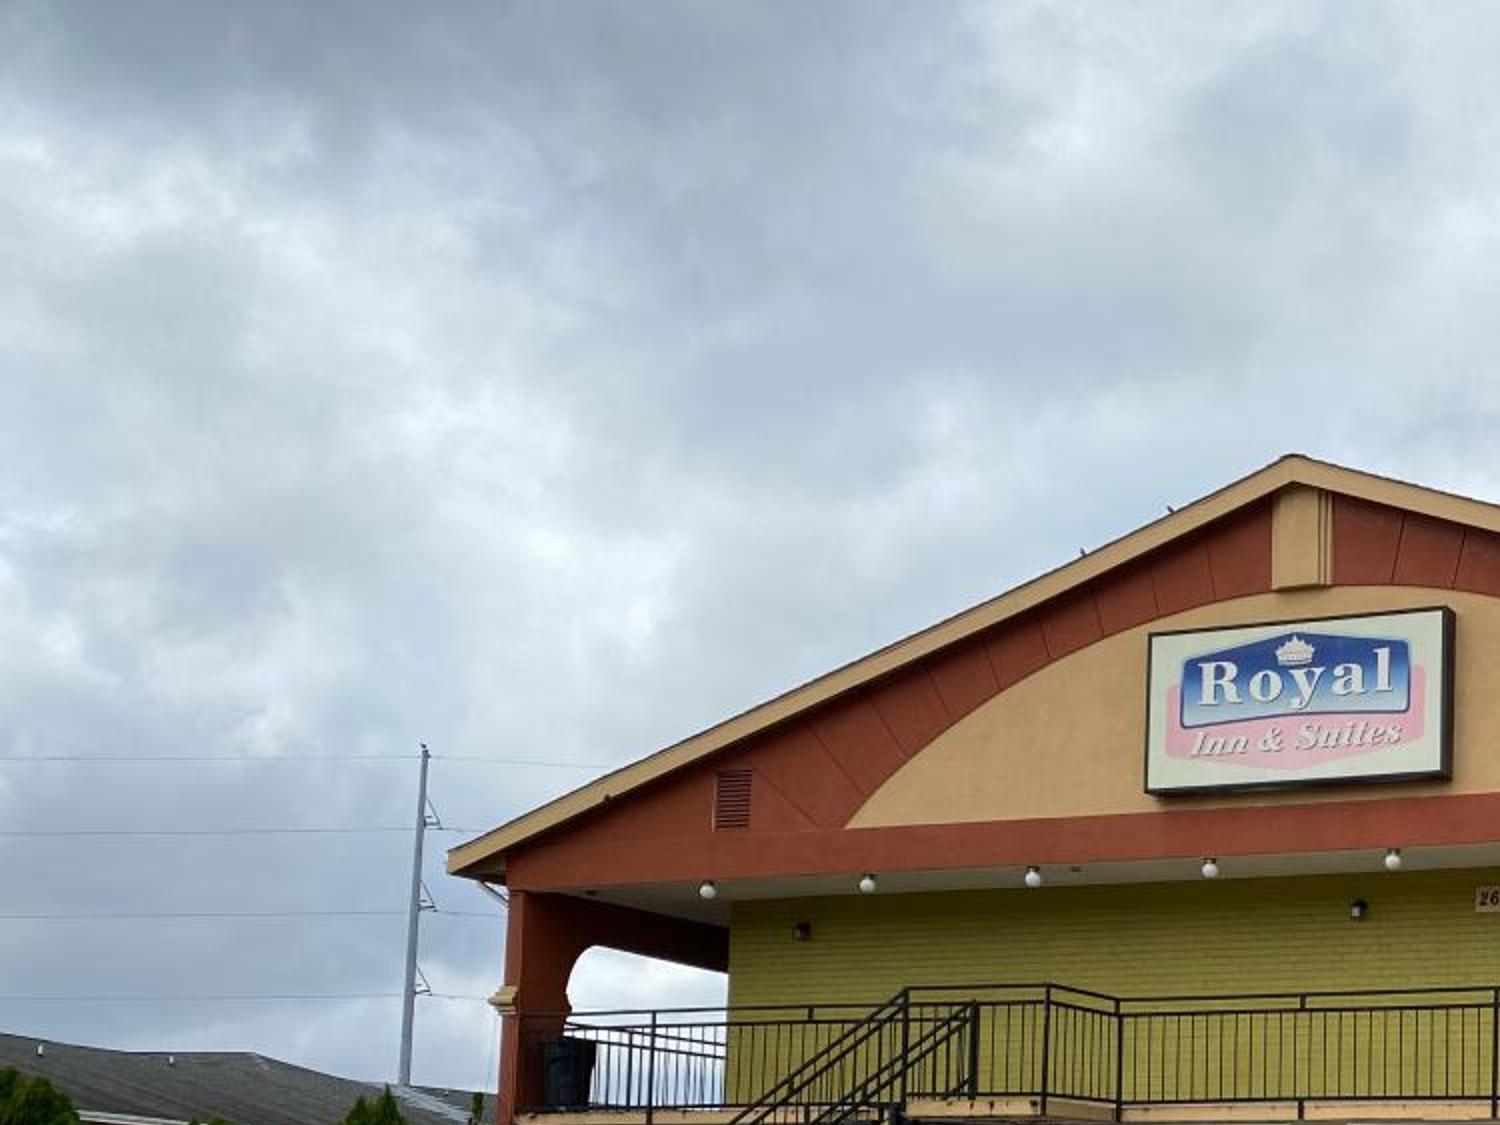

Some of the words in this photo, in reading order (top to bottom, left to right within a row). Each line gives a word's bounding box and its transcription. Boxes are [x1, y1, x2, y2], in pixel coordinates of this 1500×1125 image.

[1197, 648, 1393, 709] Royal
[1191, 731, 1249, 758] Inn
[1257, 727, 1283, 752] &
[1295, 721, 1403, 750] Suites
